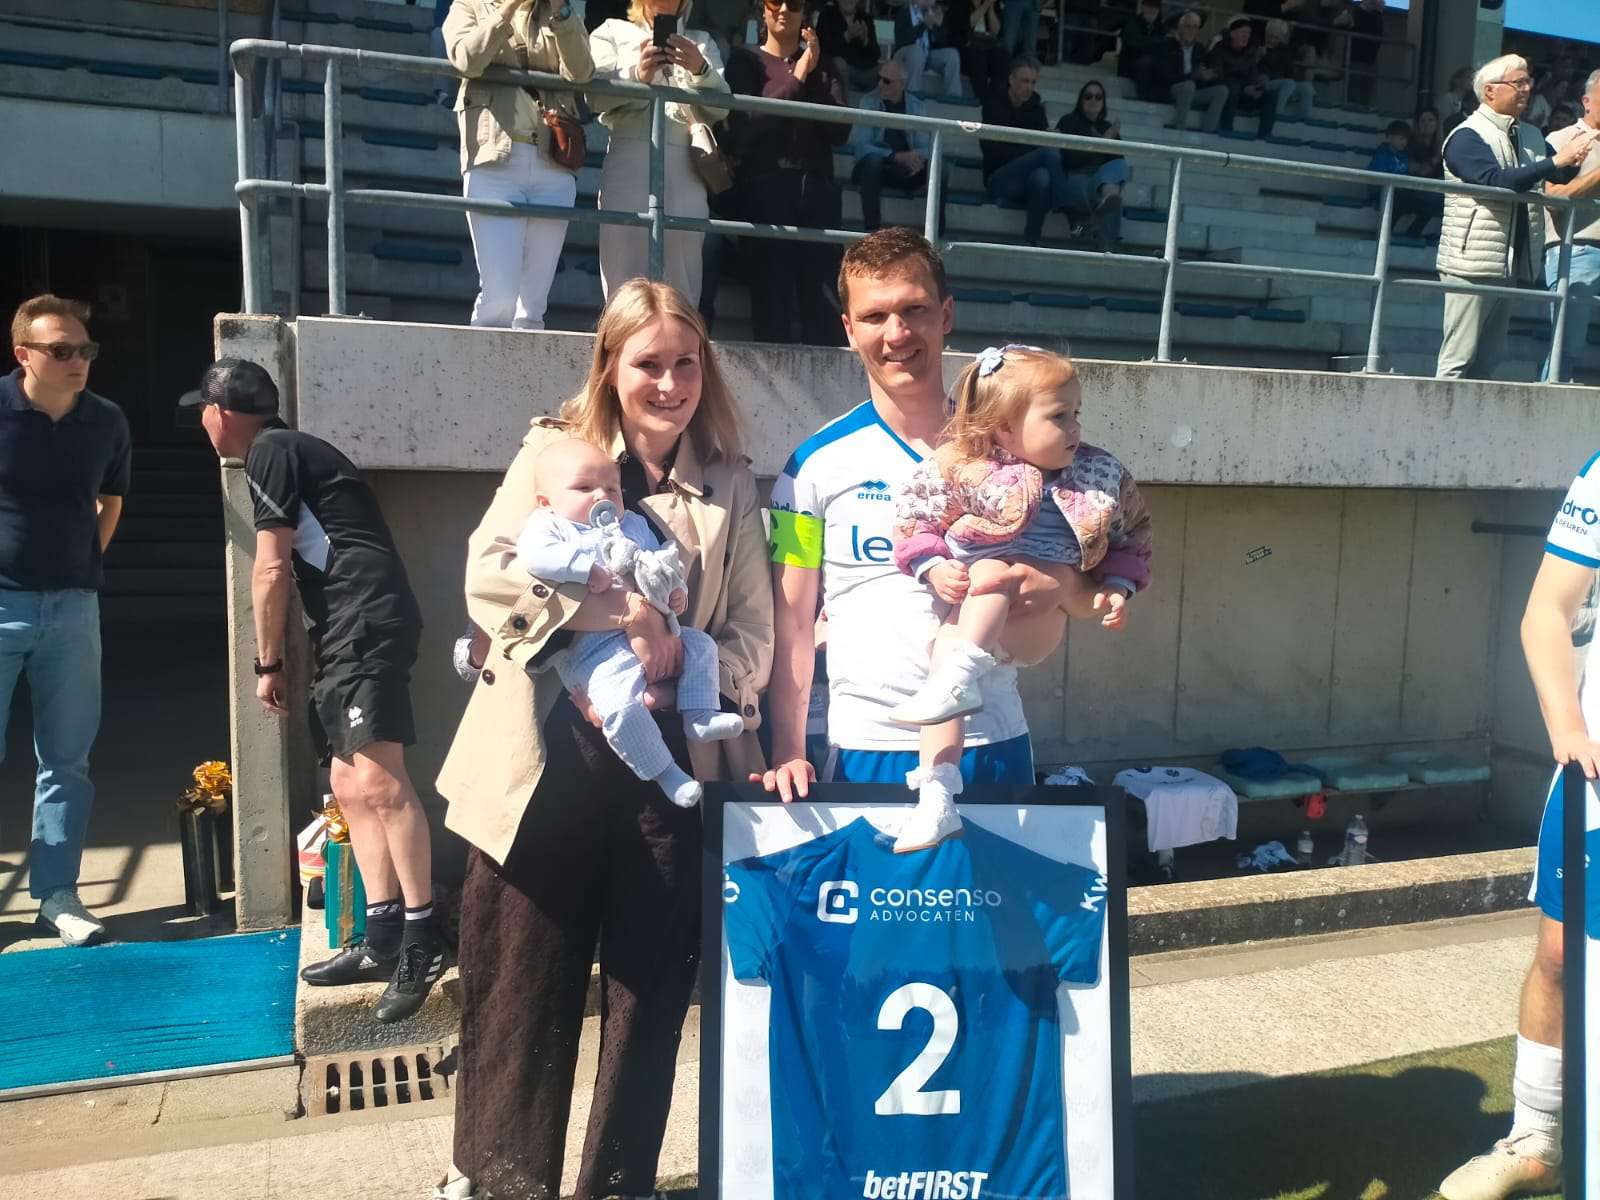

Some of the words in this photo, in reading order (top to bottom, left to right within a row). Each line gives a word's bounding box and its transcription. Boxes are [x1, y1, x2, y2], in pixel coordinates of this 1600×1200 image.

[851, 524, 894, 562] le
[870, 887, 1002, 907] consenso
[870, 910, 975, 922] ADVOCATEN
[874, 982, 961, 1115] 2
[862, 1169, 989, 1200] betFIRST
